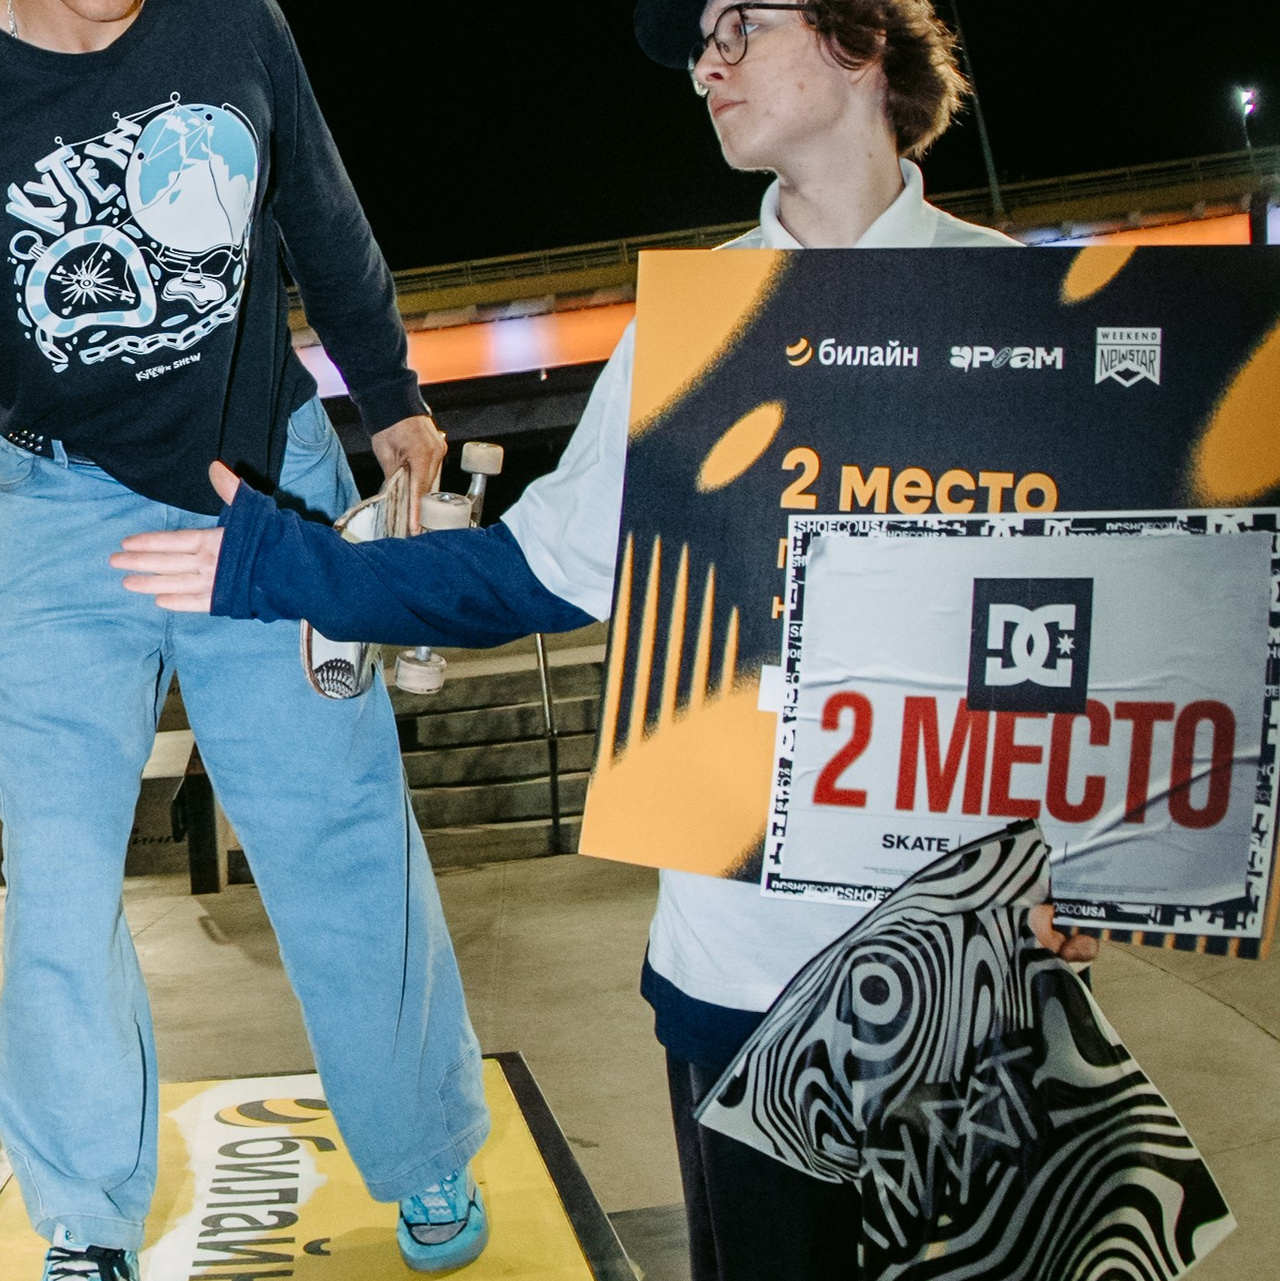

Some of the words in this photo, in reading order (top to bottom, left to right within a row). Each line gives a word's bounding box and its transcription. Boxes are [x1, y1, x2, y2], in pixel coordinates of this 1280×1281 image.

[1101, 331, 1158, 341] WEEKEND
[819, 338, 919, 367] билайн
[780, 447, 819, 510] 2
[839, 465, 1058, 515] место
[812, 691, 873, 808] 2
[895, 695, 1237, 830] МЕСТО
[882, 833, 950, 853] SKATE
